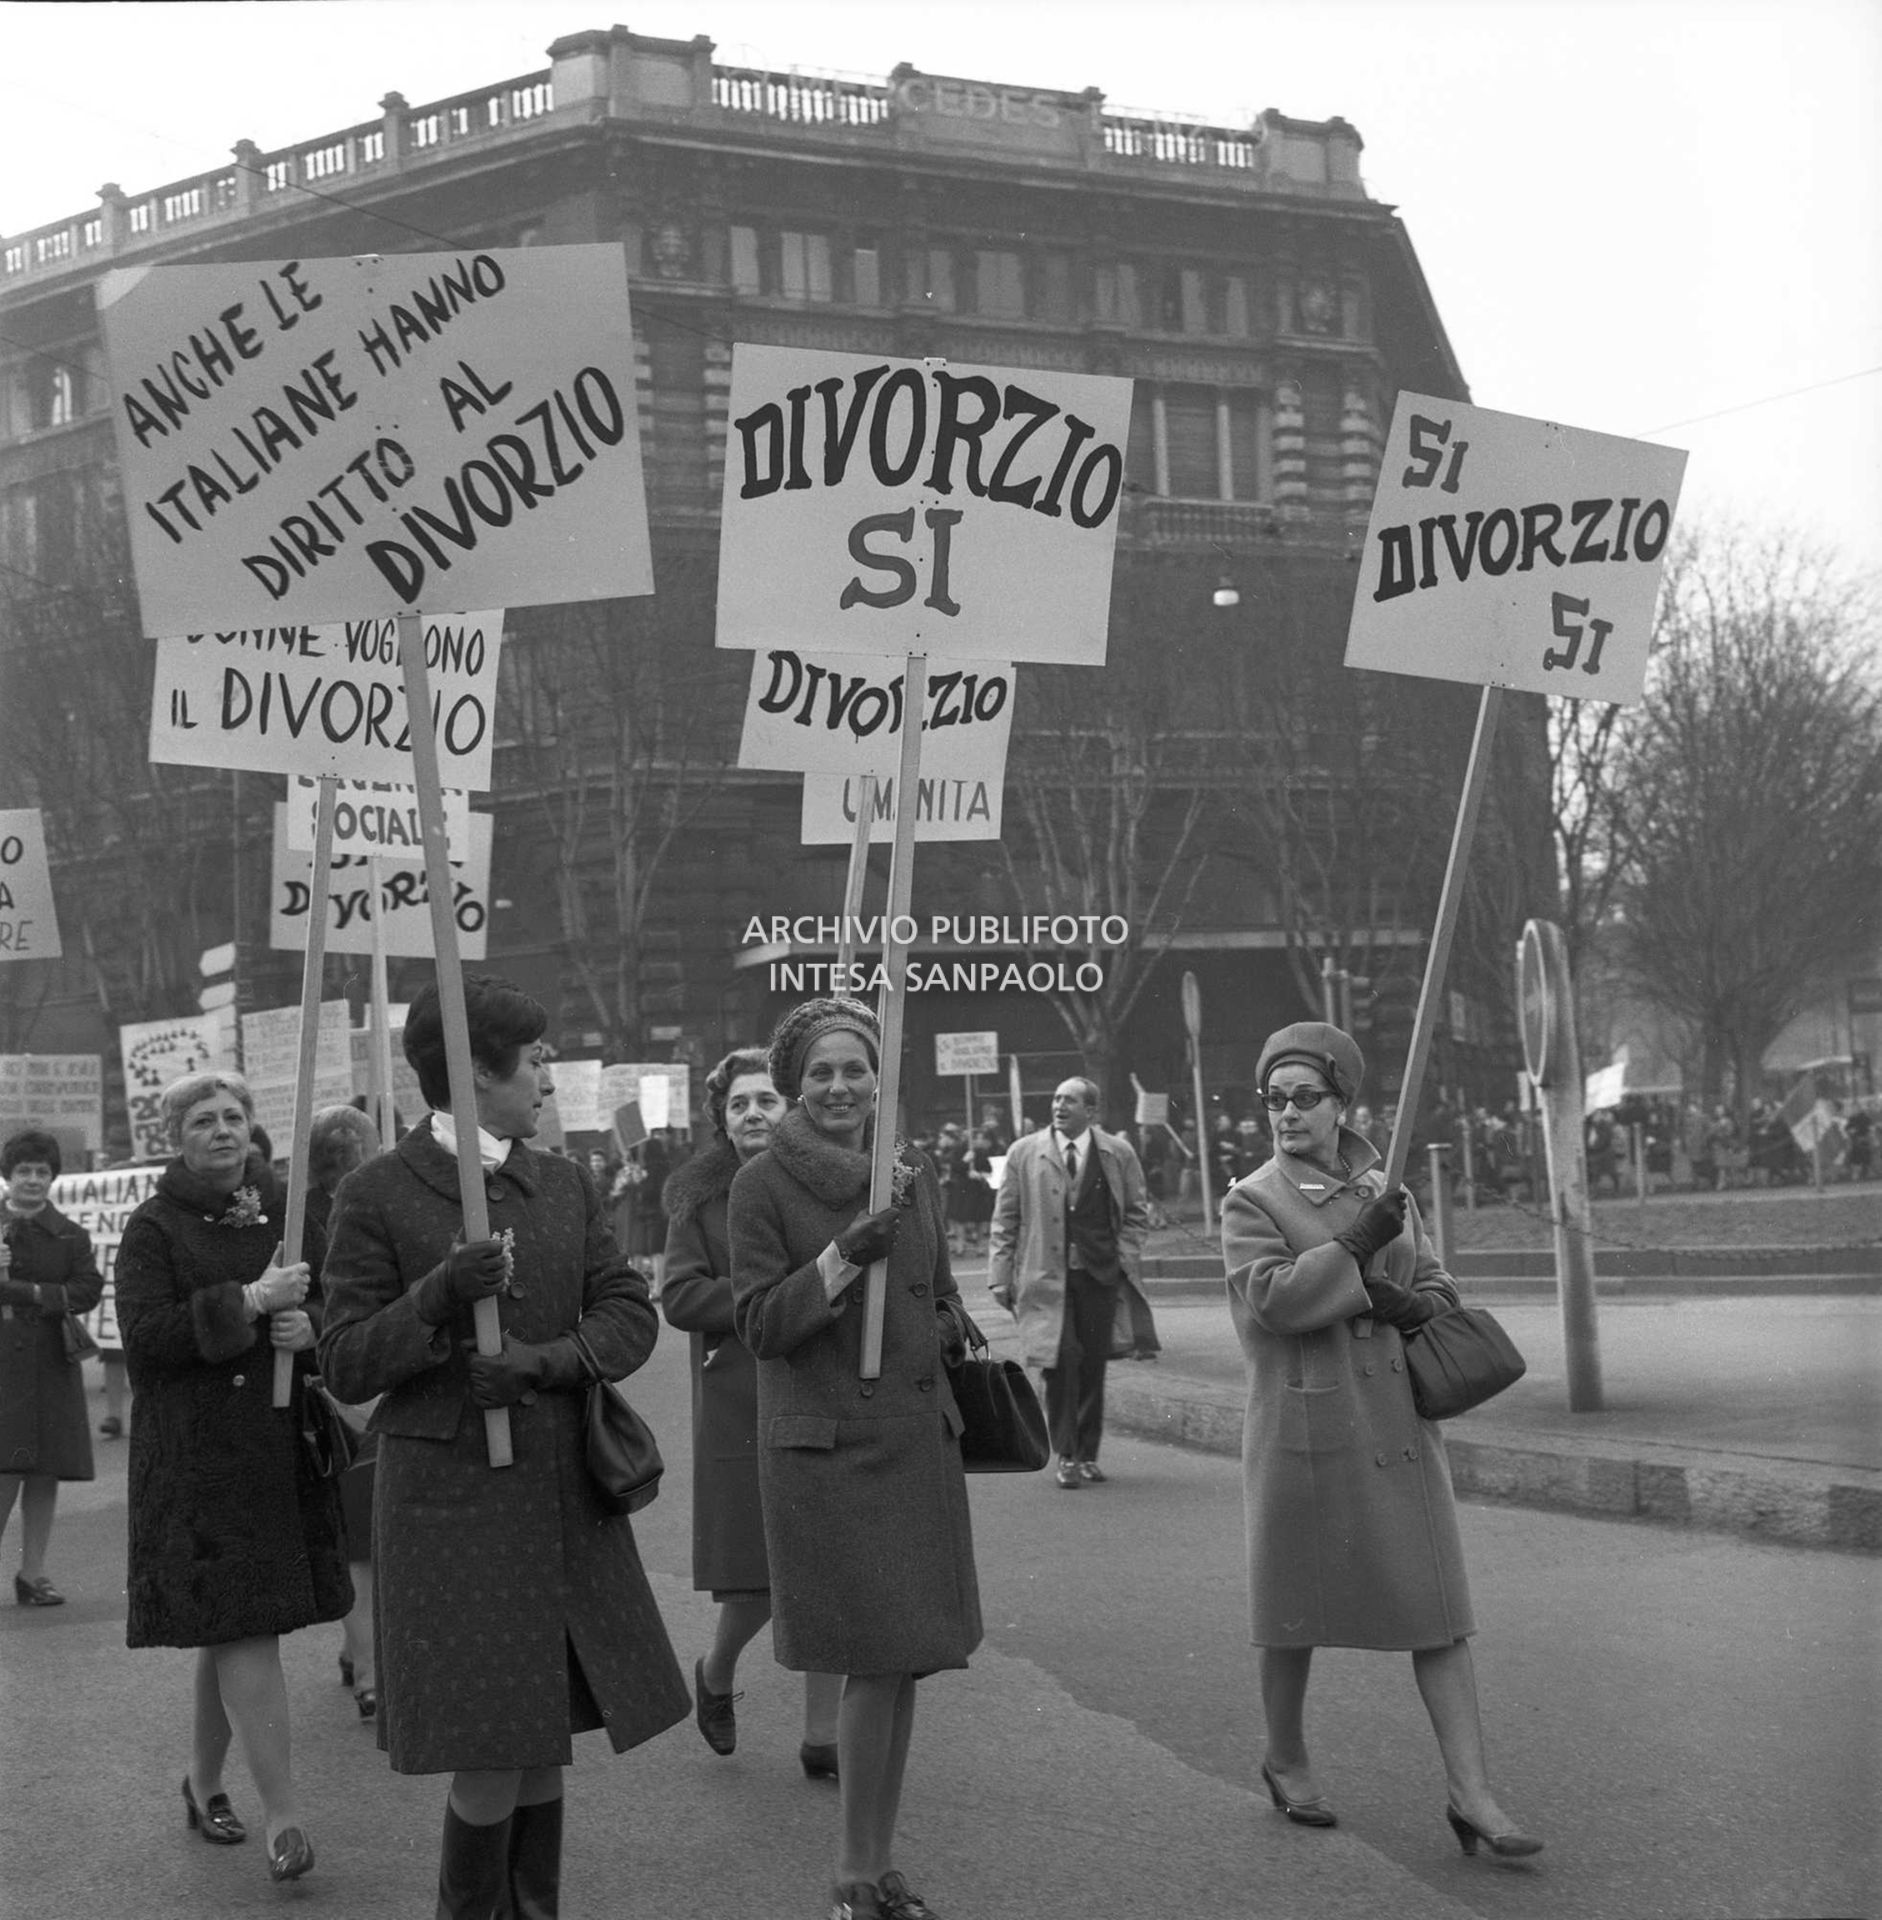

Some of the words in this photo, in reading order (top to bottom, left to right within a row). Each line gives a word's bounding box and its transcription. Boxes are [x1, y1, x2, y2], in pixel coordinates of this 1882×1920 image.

[122, 302, 264, 449] ANCHE
[260, 261, 323, 331] LE
[145, 349, 358, 544] ITALIANE
[357, 253, 506, 377] HANNO
[241, 437, 416, 601] DIRITTO
[439, 360, 513, 433] AL
[365, 366, 625, 604] DIVORZIO
[733, 364, 1123, 529] DIVORZIO
[1401, 413, 1469, 494] SI
[839, 506, 964, 617] SI
[1372, 497, 1670, 603] DIVORZIO
[345, 618, 485, 677] VOGONO
[1542, 590, 1614, 675] SI
[171, 688, 199, 729] IL
[311, 802, 451, 846] OCIAL
[842, 777, 991, 823] UMNITA
[279, 871, 486, 933] DVORIO
